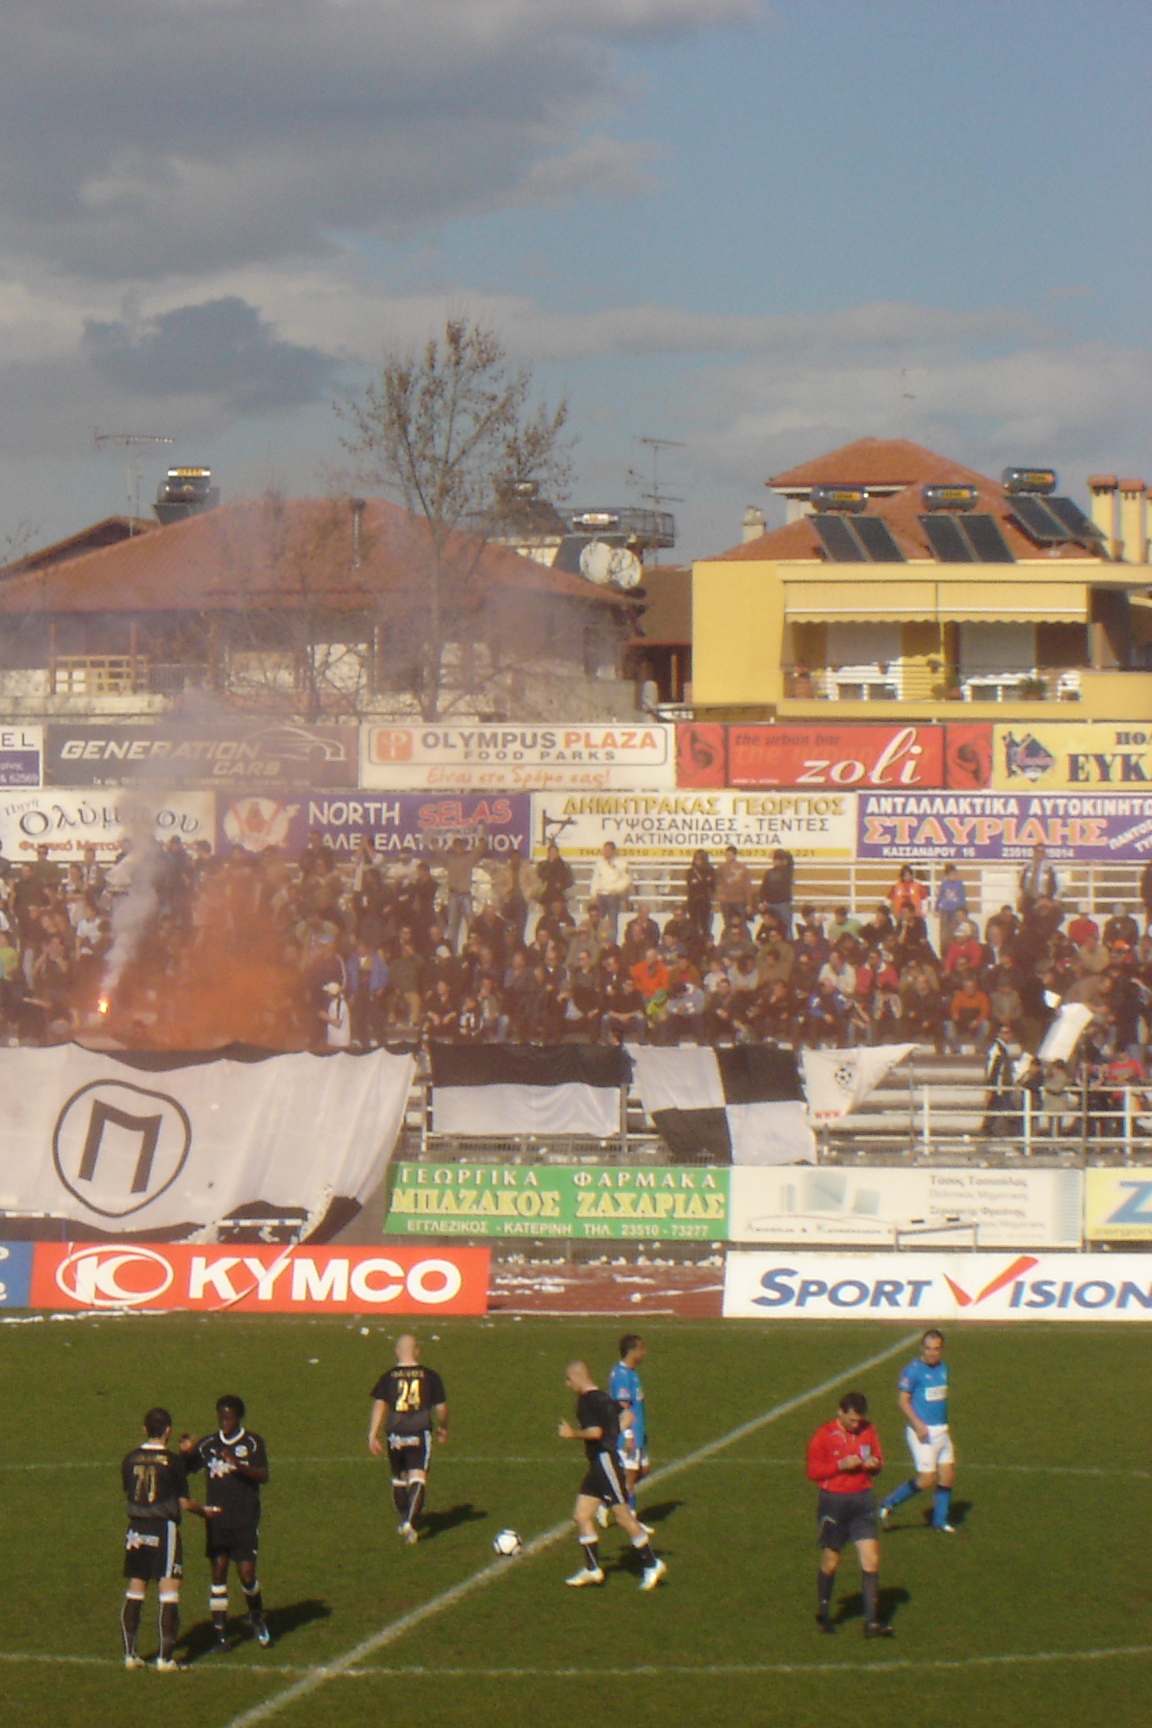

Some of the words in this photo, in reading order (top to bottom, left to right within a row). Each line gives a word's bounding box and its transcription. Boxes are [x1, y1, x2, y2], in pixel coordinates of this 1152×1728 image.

[60, 740, 260, 760] GENERATION
[421, 732, 557, 750] OLYMPUS
[564, 732, 658, 749] PLAZA
[464, 751, 525, 760] FOOD
[540, 751, 616, 760] PARKS
[213, 761, 281, 776] CARS
[1067, 753, 1152, 782] ΕΥΚ
[309, 801, 401, 825] NORTH
[418, 799, 513, 829] SELAS
[563, 796, 721, 815] ΔΗΜΗΤΡΑΚΑΣ
[866, 797, 1020, 816] ΑΝΤΑΛΛΑΚΤΙΚΑ
[19, 800, 200, 837] Ολύμου
[601, 817, 738, 832] ΓΥΨΟΣΑΝΙΔΕΣ
[756, 817, 829, 832] ΤΕΝΤΕΣ
[309, 833, 362, 850] ΑΛΕ
[623, 832, 782, 846] ΑΚΤΙΝΟΠΡΟΣΤΑΣΙΑ
[863, 816, 1110, 847] ΣΤΑΥΡΙΔΗΣ
[401, 1168, 540, 1187] ΓΕΩΡΓΙΚΑ
[573, 1173, 717, 1189] ΦΑΡΜΑΚΑ
[390, 1187, 561, 1218] ΜΠΑΖΑΚΟΣ
[576, 1192, 726, 1220] ΖΑΧΑΡΙΑΣ
[504, 1222, 573, 1236] ΚΑΤΕΡΙΝΗ
[621, 1224, 660, 1237] 23510
[188, 1256, 462, 1304] KYMCO
[750, 1267, 934, 1308] SPORT
[395, 1379, 421, 1412] 24
